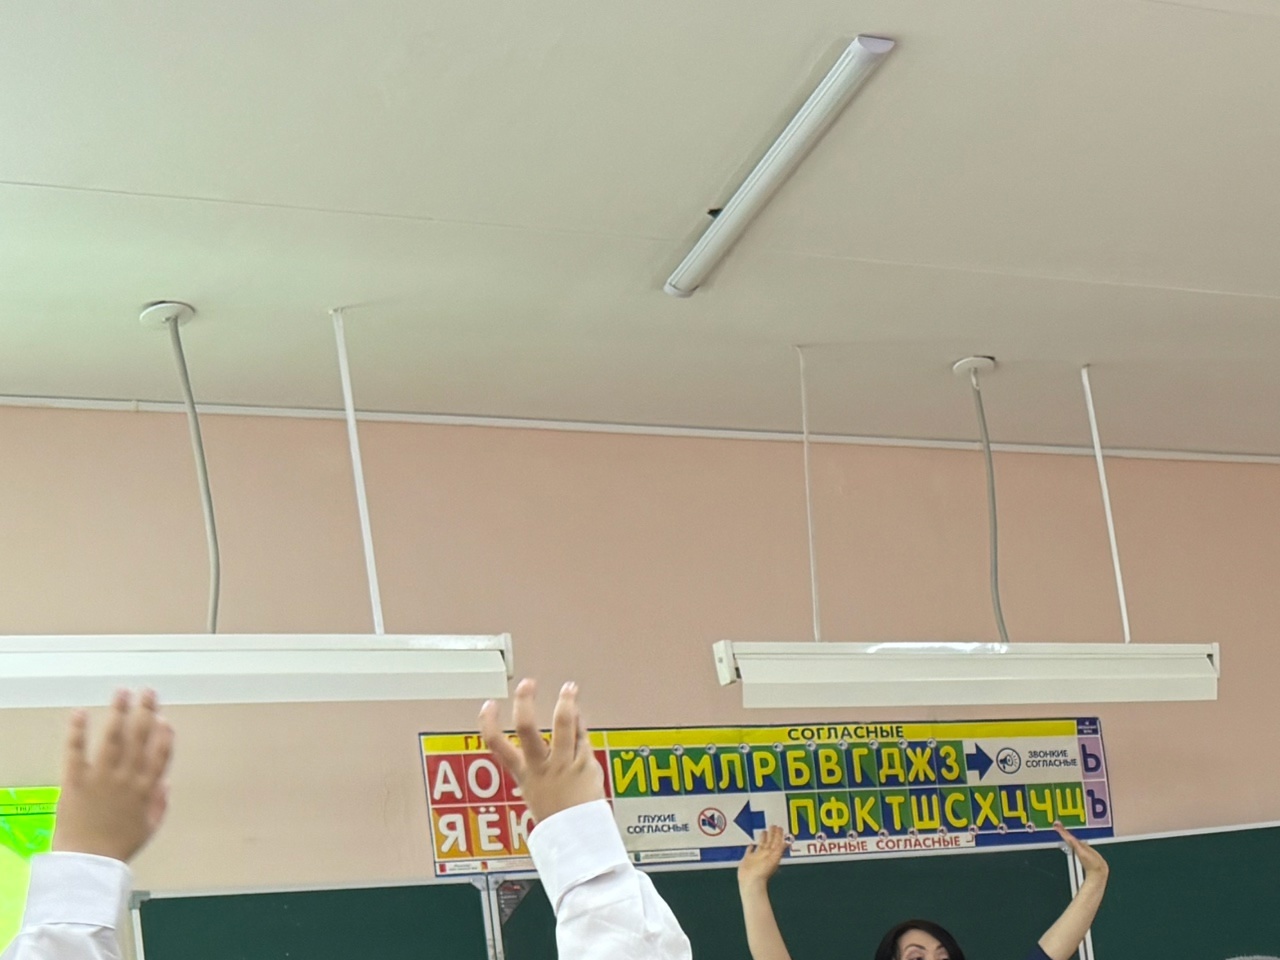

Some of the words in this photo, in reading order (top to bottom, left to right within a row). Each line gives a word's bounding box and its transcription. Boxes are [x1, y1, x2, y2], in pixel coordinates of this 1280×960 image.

[787, 725, 904, 741] СОГЛАСНЫЕ
[1028, 750, 1068, 759] ЗВОНКИЕ
[1025, 758, 1078, 768] СОГЛАСНЫЕ
[637, 813, 677, 824] ГЛУХИЕ
[627, 823, 690, 835] СОГЛАСНЫЕ
[807, 839, 868, 854] ПАРНЫЕ
[876, 836, 961, 850] СОГЛАСНЫЕ
